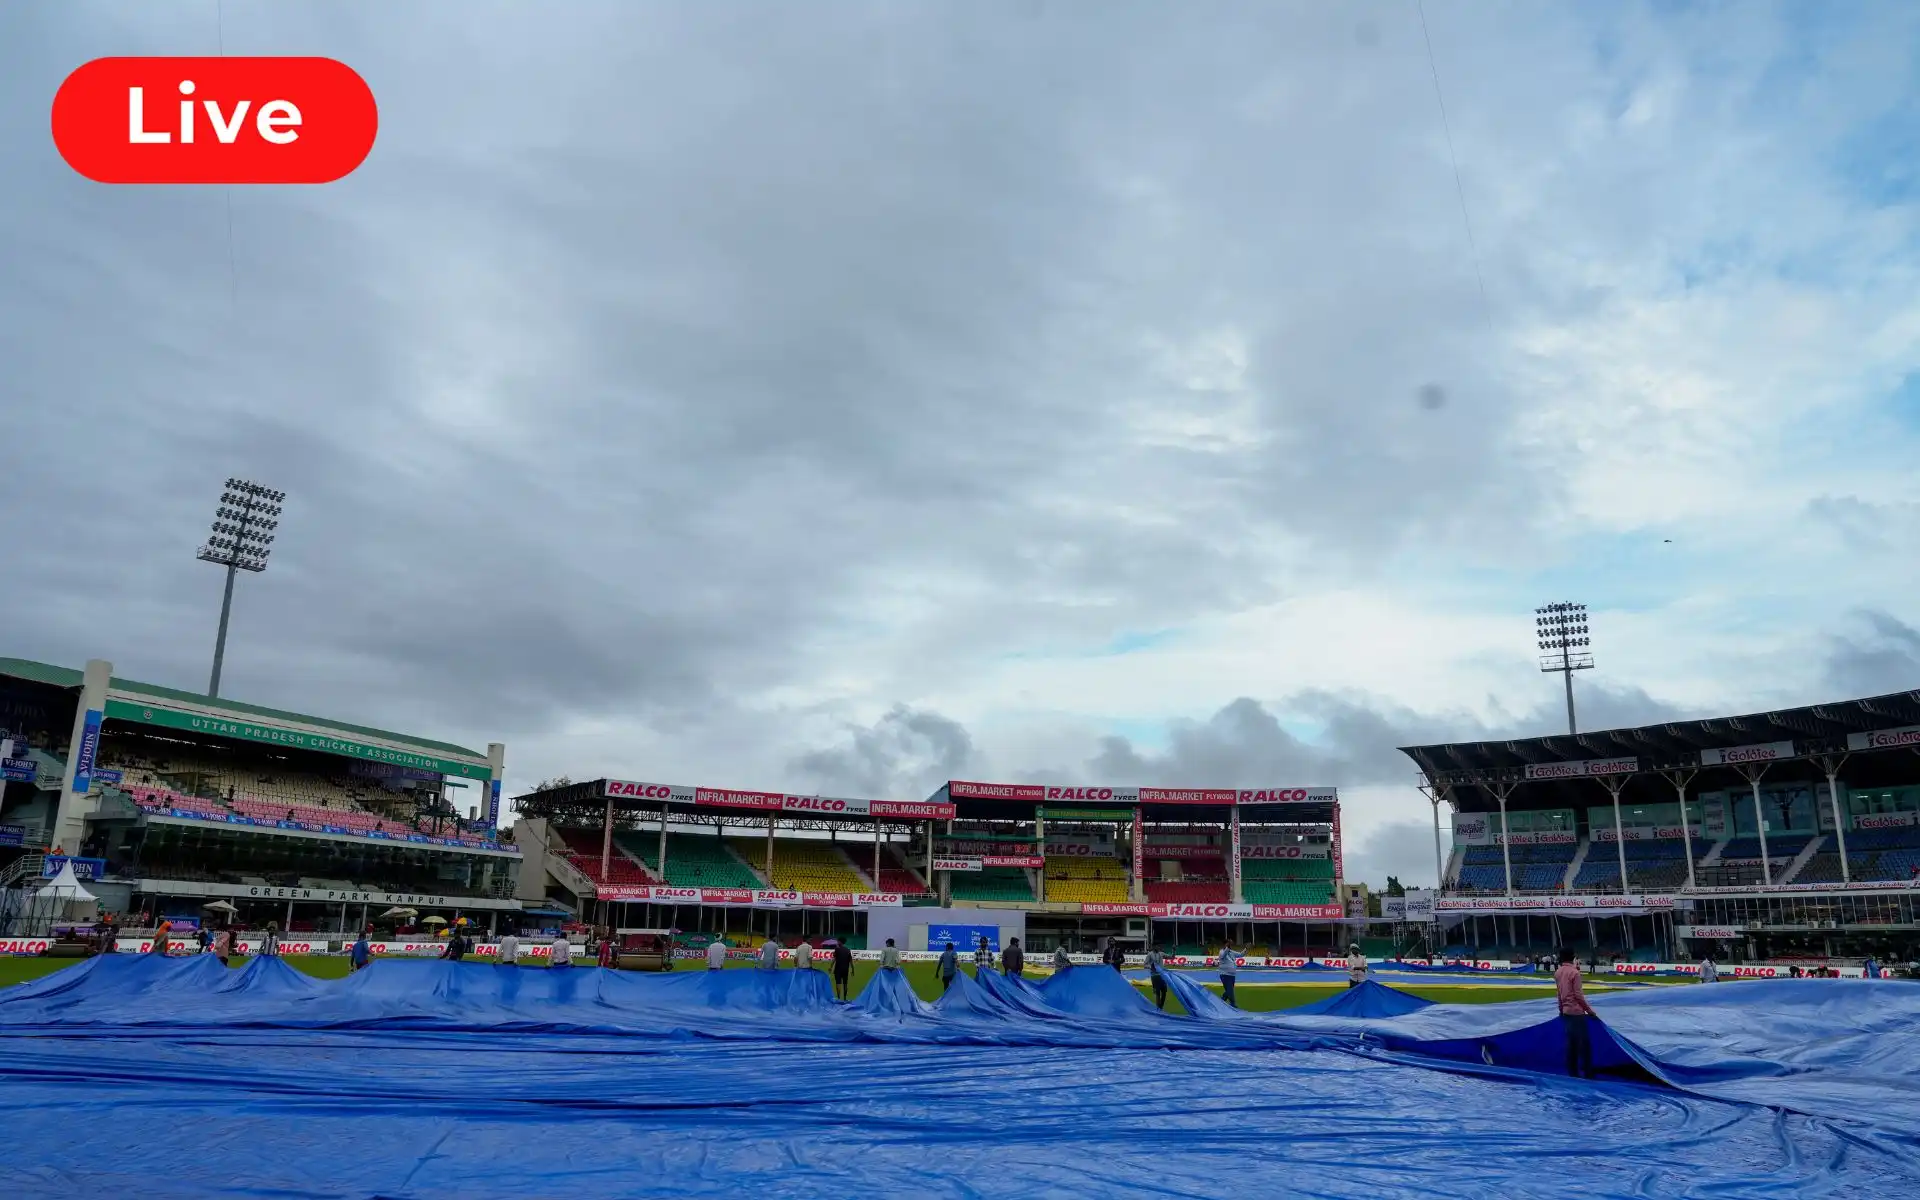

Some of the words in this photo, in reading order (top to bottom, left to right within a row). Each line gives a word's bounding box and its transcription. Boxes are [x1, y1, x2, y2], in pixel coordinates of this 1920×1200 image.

[192, 718, 237, 733] UTTAR
[245, 727, 304, 745] PRADESH
[310, 738, 361, 754] CRICKET
[367, 749, 438, 769] ASSOCIATION
[1876, 732, 1920, 745] Goldie
[79, 732, 95, 775] VI-JOHN
[1728, 747, 1776, 760] Goldiee
[5, 758, 34, 769] VI-JOHN
[1591, 762, 1635, 773] Goldiee
[1536, 766, 1578, 777] Goldiee
[608, 782, 671, 798] RALCO
[697, 791, 765, 805] INFRA.MARKET
[953, 783, 1014, 796] INFRA.MARKET
[1047, 788, 1112, 800] RALCO
[1141, 790, 1204, 800] INFRA.MARKET
[1239, 790, 1306, 801] RALCO
[785, 797, 845, 811] RALCO
[871, 803, 937, 815] INFRA.MARKET
[1862, 817, 1906, 828] Goldiee
[251, 886, 310, 898] GREEN
[328, 891, 370, 901] PARK
[386, 895, 445, 905] KANPUR
[598, 886, 647, 895] INFRA.MARKET
[655, 889, 696, 897] RALCO
[702, 890, 752, 898] INFRA.MARKET
[757, 891, 797, 900] RALCO
[1084, 904, 1149, 913] INFRA.MARKET
[1170, 905, 1228, 916] RALCO
[1255, 907, 1323, 917] INFRA.MARKET
[1697, 929, 1731, 937] Goldiee
[279, 943, 310, 953] ALCO
[1734, 967, 1775, 976] RALCO
